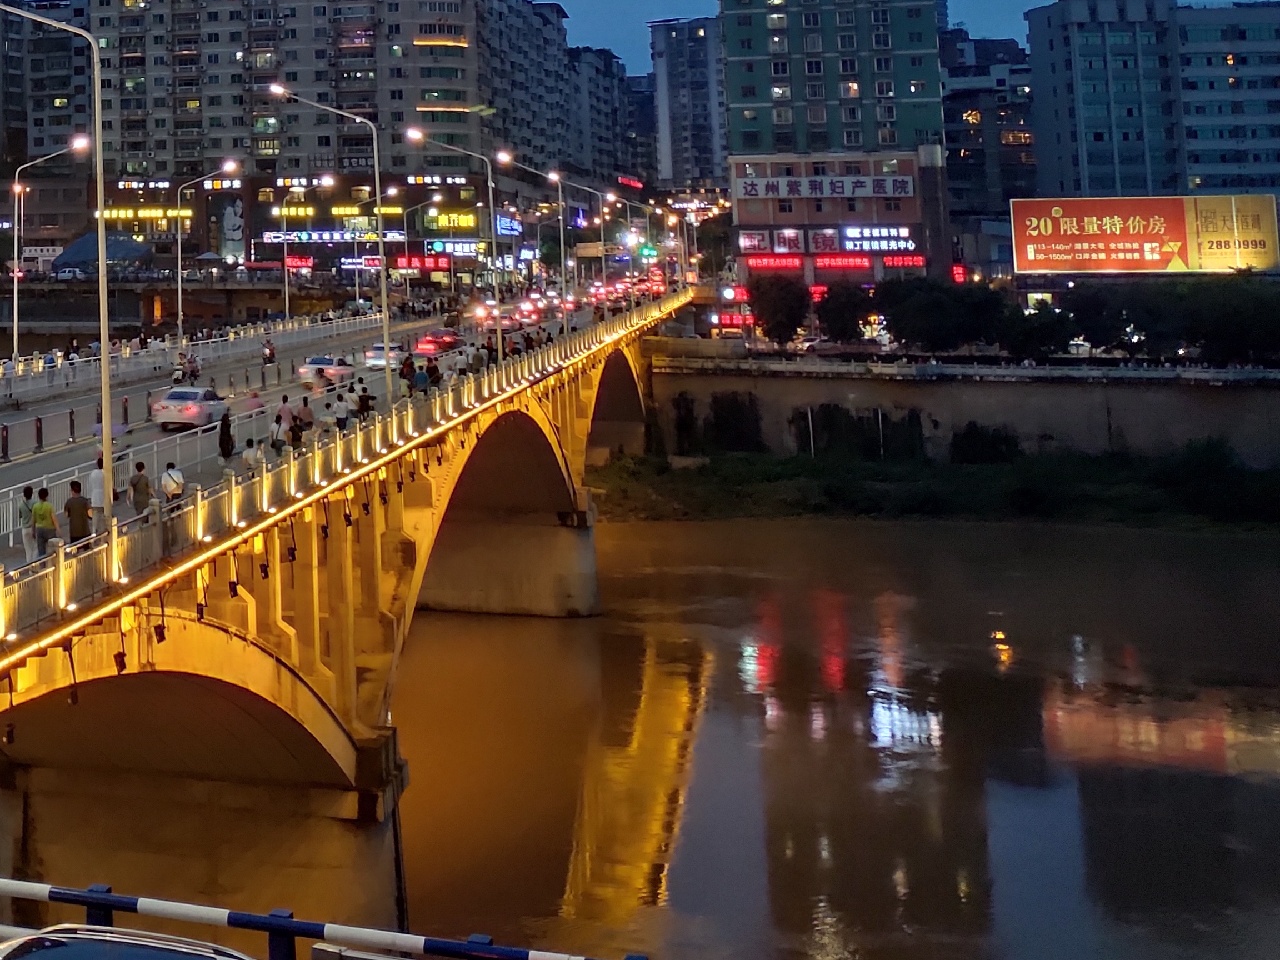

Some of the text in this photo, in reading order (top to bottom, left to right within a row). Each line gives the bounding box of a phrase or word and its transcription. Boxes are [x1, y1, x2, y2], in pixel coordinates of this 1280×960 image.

[743, 178, 910, 197] 达州紫荆妇产医院
[1060, 216, 1167, 235] 限量特价房
[743, 231, 838, 252] 配眼镜
[1207, 240, 1231, 250] 288
